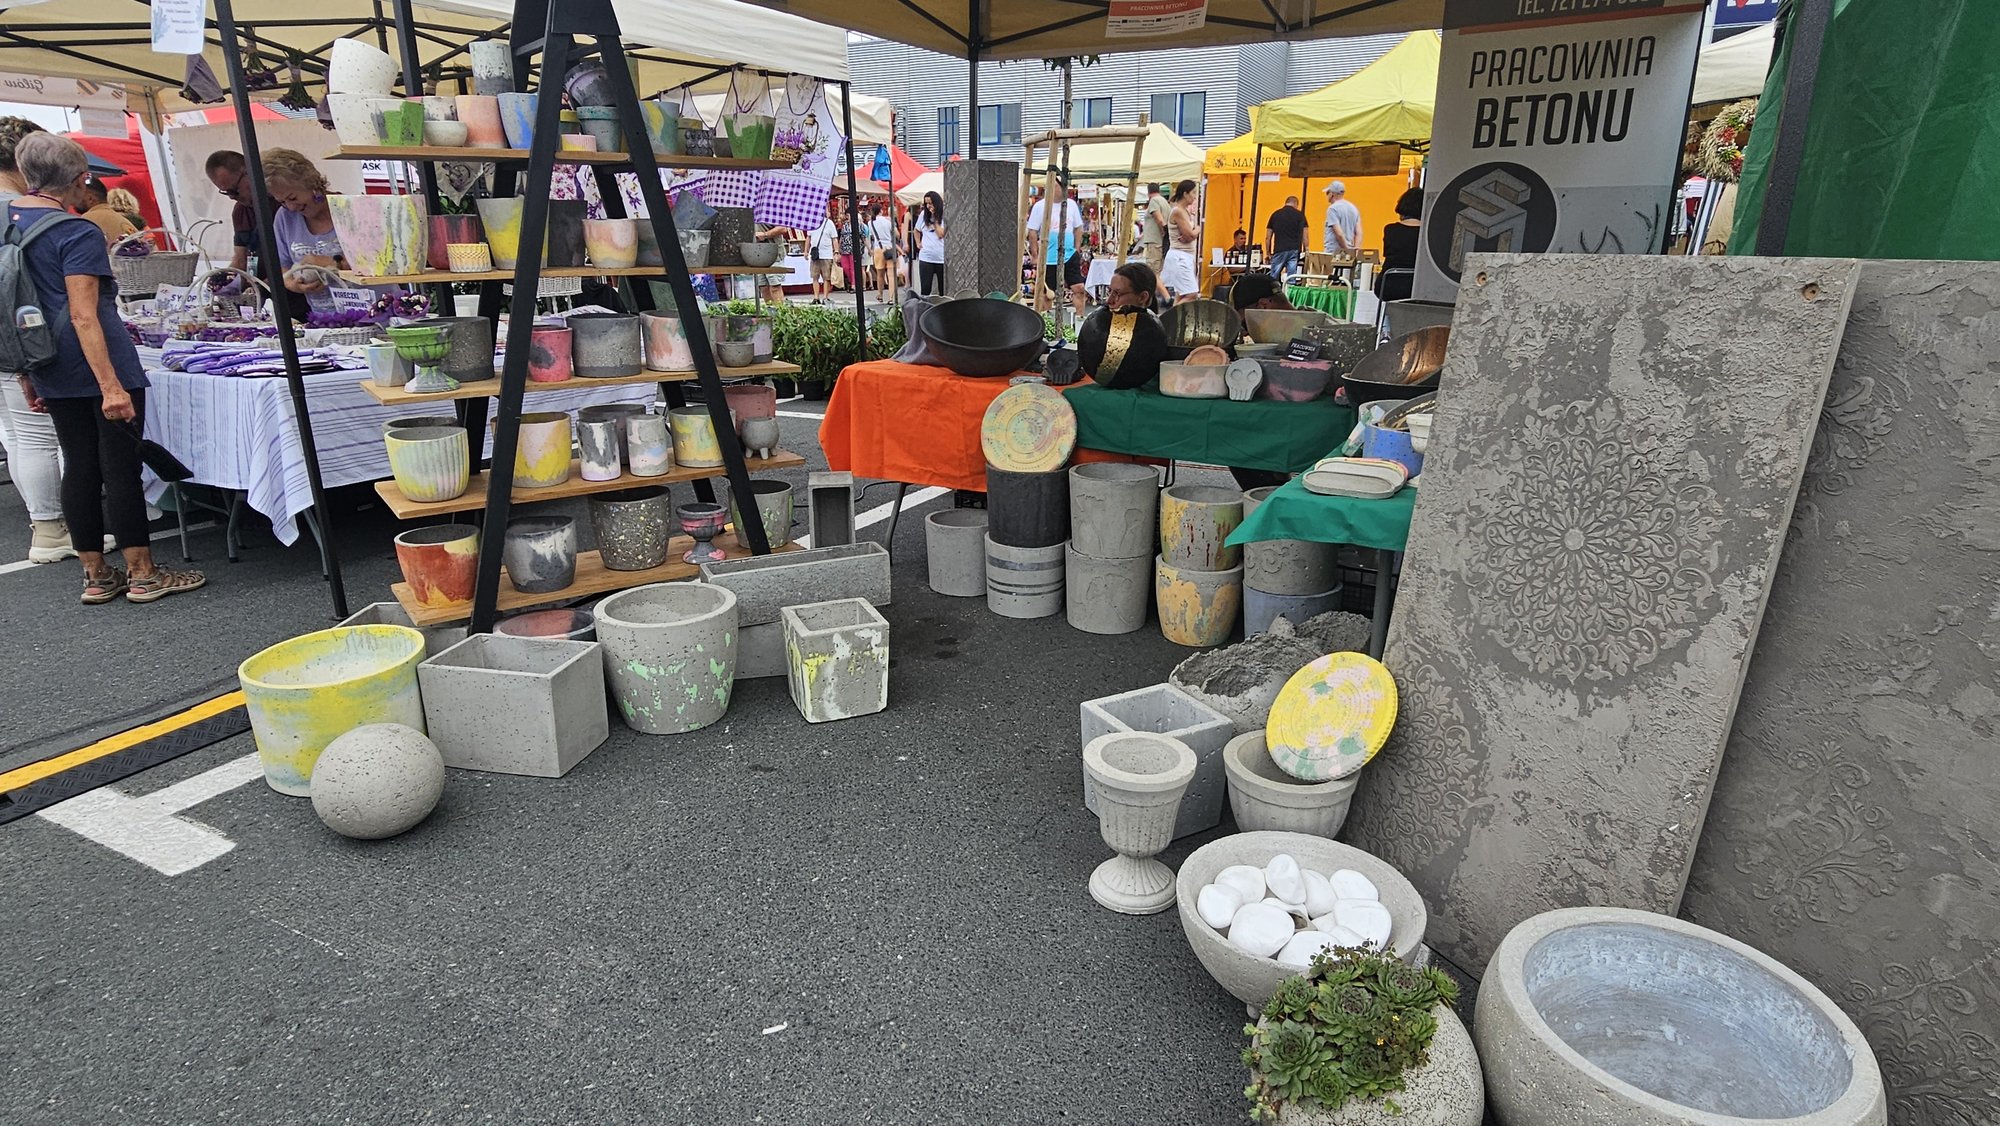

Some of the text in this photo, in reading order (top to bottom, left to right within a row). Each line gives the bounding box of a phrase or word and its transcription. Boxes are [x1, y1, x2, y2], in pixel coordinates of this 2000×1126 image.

[1516, 0, 1545, 16] TEL.
[1468, 35, 1656, 89] PRACOWNIA
[1471, 87, 1635, 149] BETONU
[170, 294, 197, 303] SYOP
